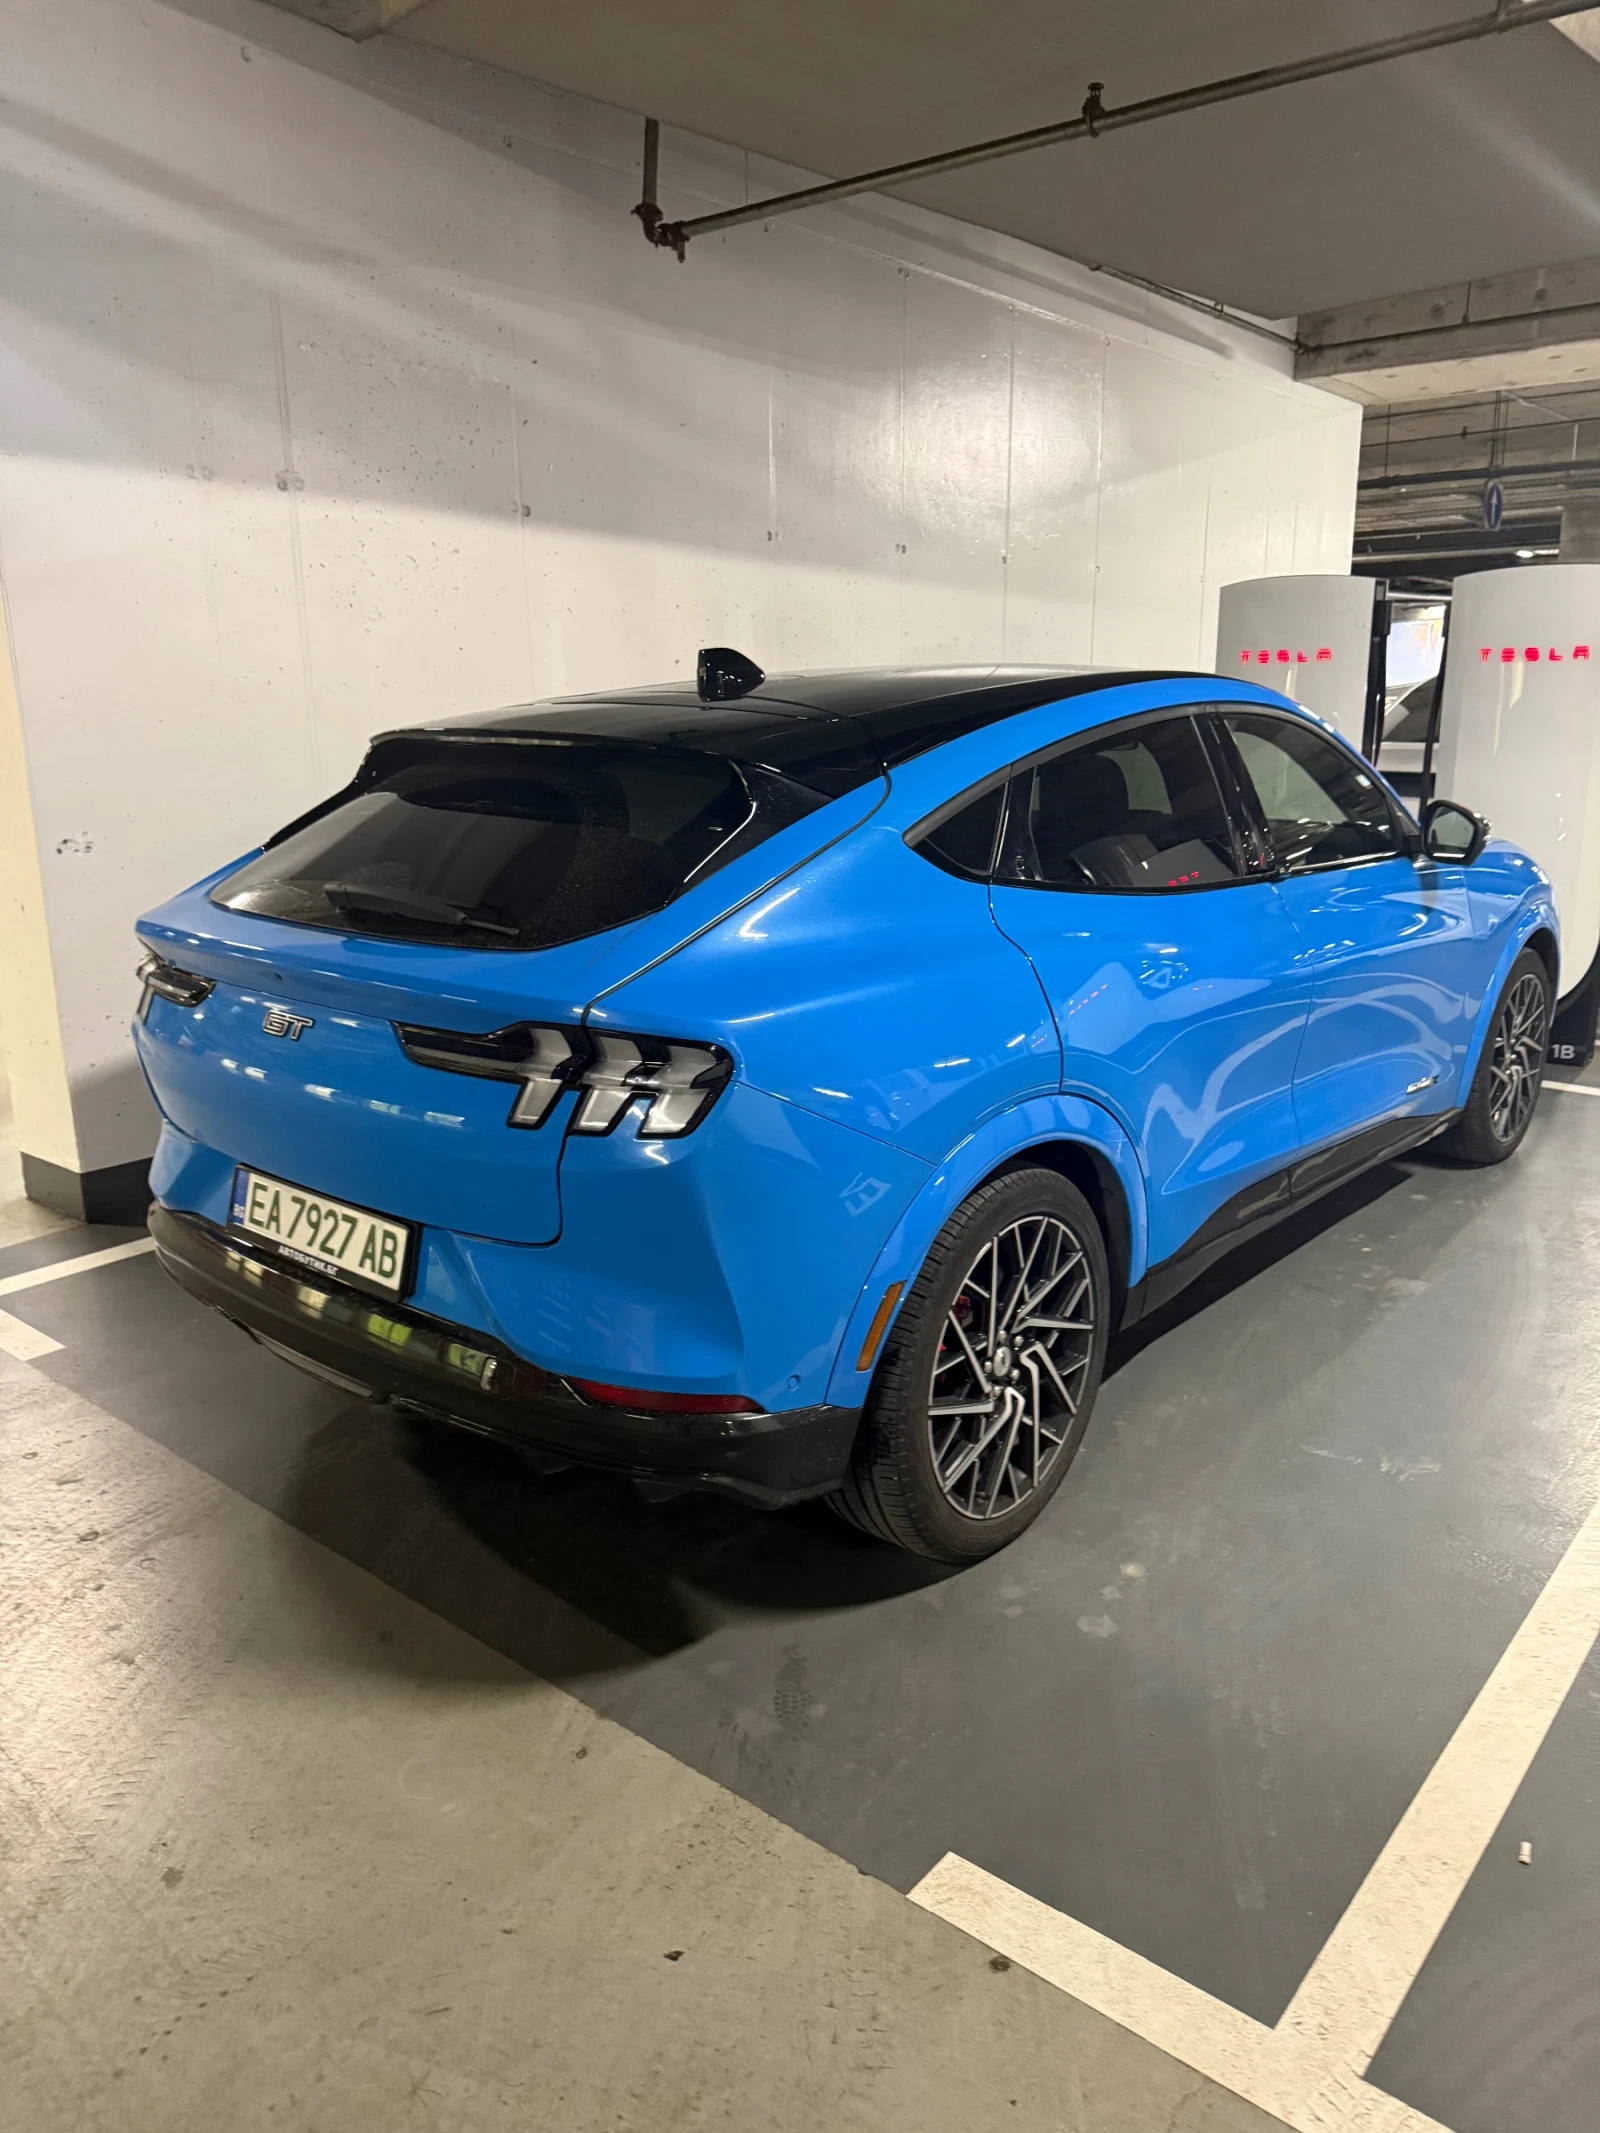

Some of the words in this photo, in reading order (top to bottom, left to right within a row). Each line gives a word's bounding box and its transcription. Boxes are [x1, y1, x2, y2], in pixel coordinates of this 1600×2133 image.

[1239, 648, 1332, 664] TESLA
[1479, 645, 1590, 663] TESLA
[263, 1009, 314, 1040] GT
[1551, 1044, 1575, 1059] 1B
[248, 1181, 281, 1235] EA
[286, 1195, 358, 1260] 7927
[358, 1223, 399, 1279] AB
